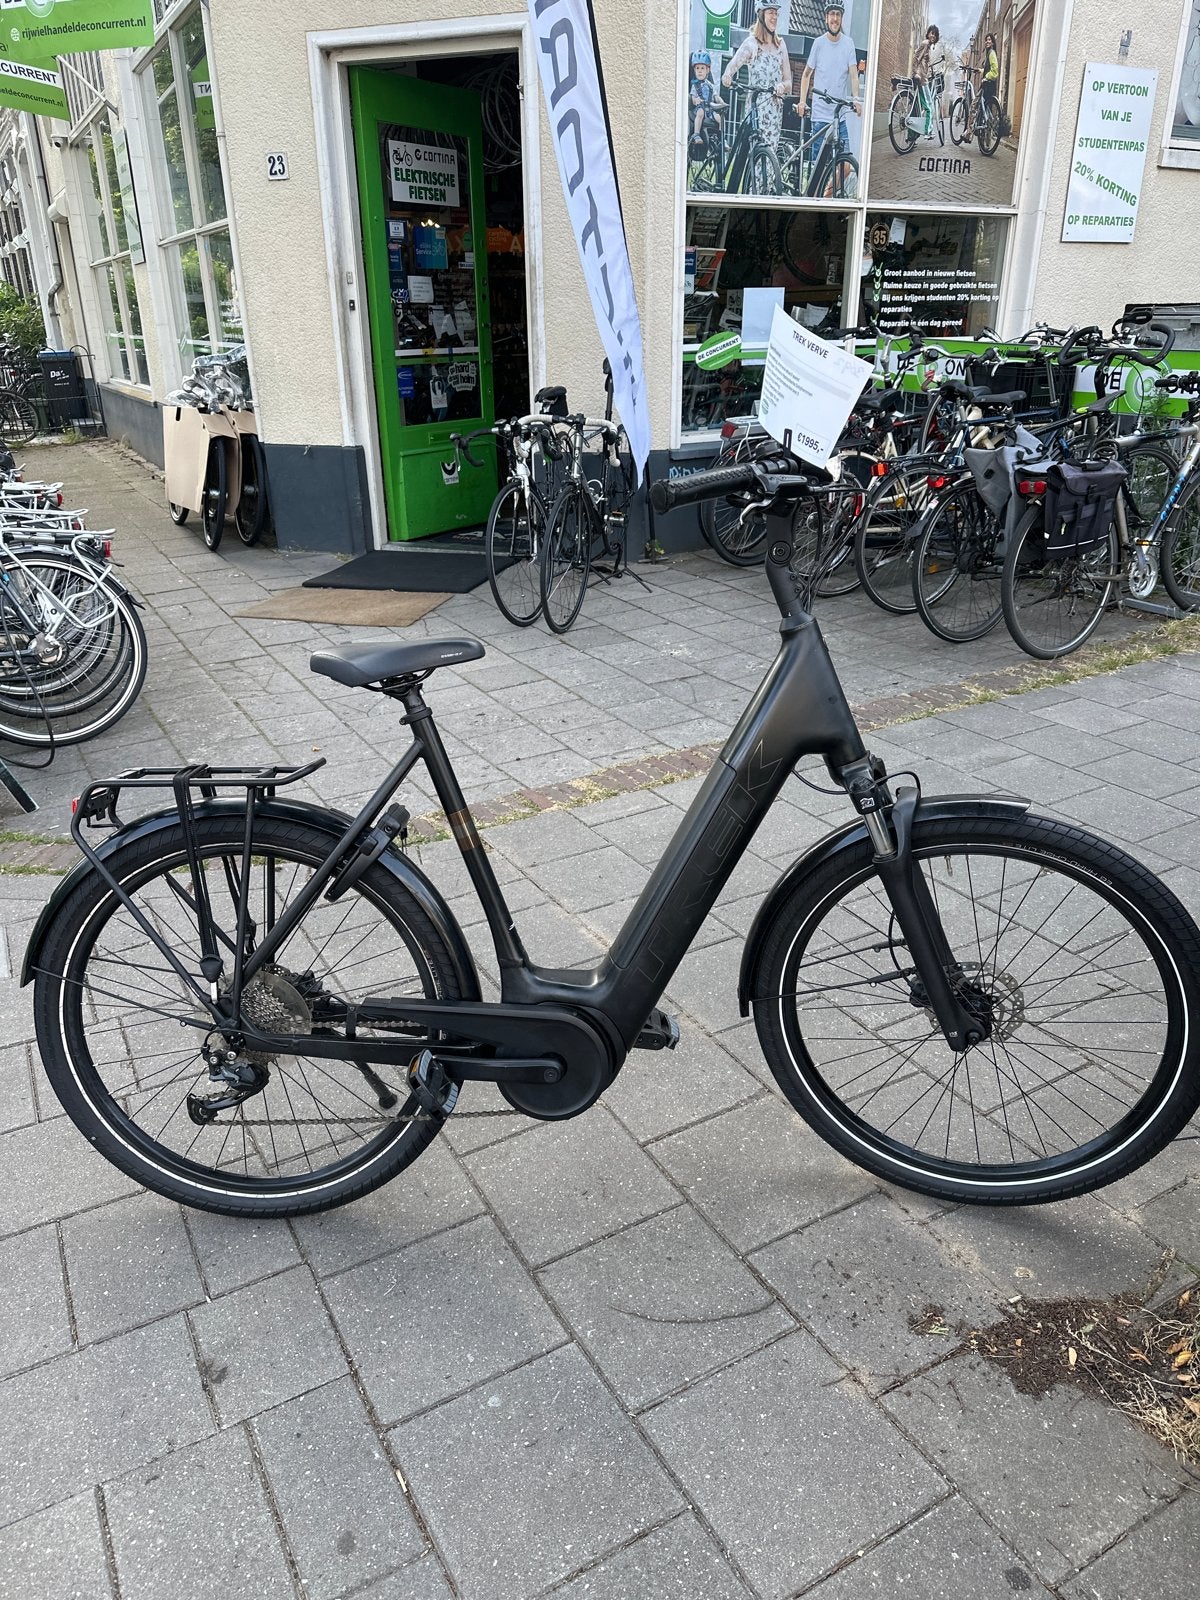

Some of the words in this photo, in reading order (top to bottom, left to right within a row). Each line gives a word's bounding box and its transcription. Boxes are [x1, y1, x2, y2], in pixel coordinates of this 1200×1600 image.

[22, 16, 147, 41] rijwielhandeldeconcurrent.nl
[0, 62, 57, 84] CURRENT
[1092, 80, 1105, 93] OP
[1107, 82, 1149, 97] VERTOON
[0, 87, 64, 108] eldeconcurrent.nl
[1101, 109, 1119, 121] VAN
[1120, 111, 1133, 122] JE
[1078, 137, 1145, 152] STUDENTENPAS
[268, 155, 286, 175] 23
[394, 167, 456, 188] ELEKTRISCHE
[1074, 160, 1095, 182] 20%
[1095, 173, 1138, 207] KORTING
[408, 185, 447, 202] FIETSEN
[1067, 214, 1080, 226] OP
[1082, 214, 1134, 227] REPARATIES
[873, 230, 887, 245] 35
[884, 269, 902, 277] Groot
[902, 269, 926, 277] aanbod
[926, 269, 933, 277] in
[956, 269, 977, 277] fietsen
[929, 282, 948, 290] goede
[949, 281, 978, 290] gebruikte
[881, 294, 891, 303] Bij
[904, 294, 926, 303] krijgen
[926, 294, 956, 302] studenten
[970, 294, 991, 303] korting
[991, 294, 1000, 303] op
[881, 305, 913, 314] reparaties
[879, 319, 909, 328] Reparatie
[910, 319, 917, 327] in
[929, 319, 941, 328] dag
[941, 318, 963, 327] gereed
[705, 337, 739, 357] CONCURRENT
[792, 330, 807, 347] TREK
[807, 340, 830, 359] VERVE
[797, 432, 824, 454] €1995,-
[623, 739, 784, 987] TREK
